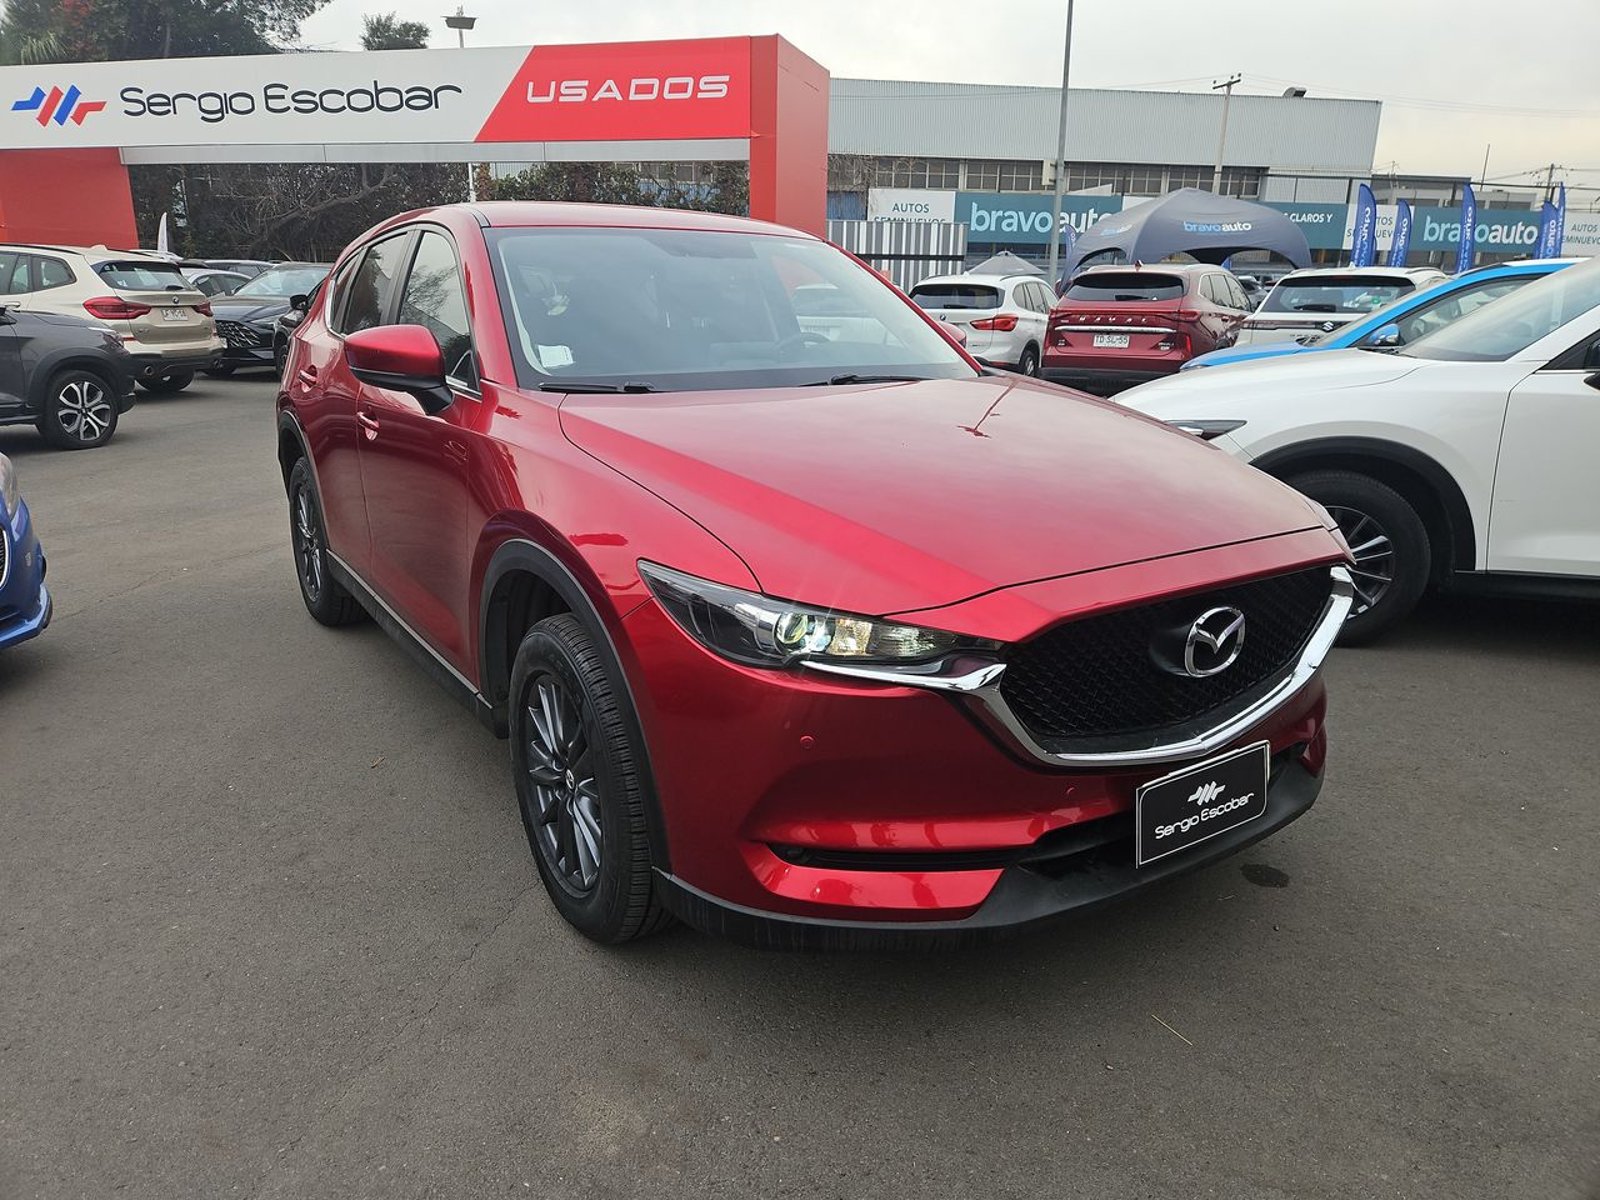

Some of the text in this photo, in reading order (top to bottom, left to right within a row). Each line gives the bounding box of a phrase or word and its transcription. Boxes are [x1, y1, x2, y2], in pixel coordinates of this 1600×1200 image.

[527, 75, 731, 103] USADOS
[119, 80, 462, 123] Sergio Escobar
[892, 203, 930, 213] AUTOS
[1289, 212, 1325, 223] CLAROS
[1326, 213, 1334, 223] Y
[1183, 221, 1252, 232] bravoauto
[1423, 215, 1539, 245] braoauto
[1570, 224, 1598, 233] AUTOS
[1155, 792, 1255, 839] Sergio Escobar
